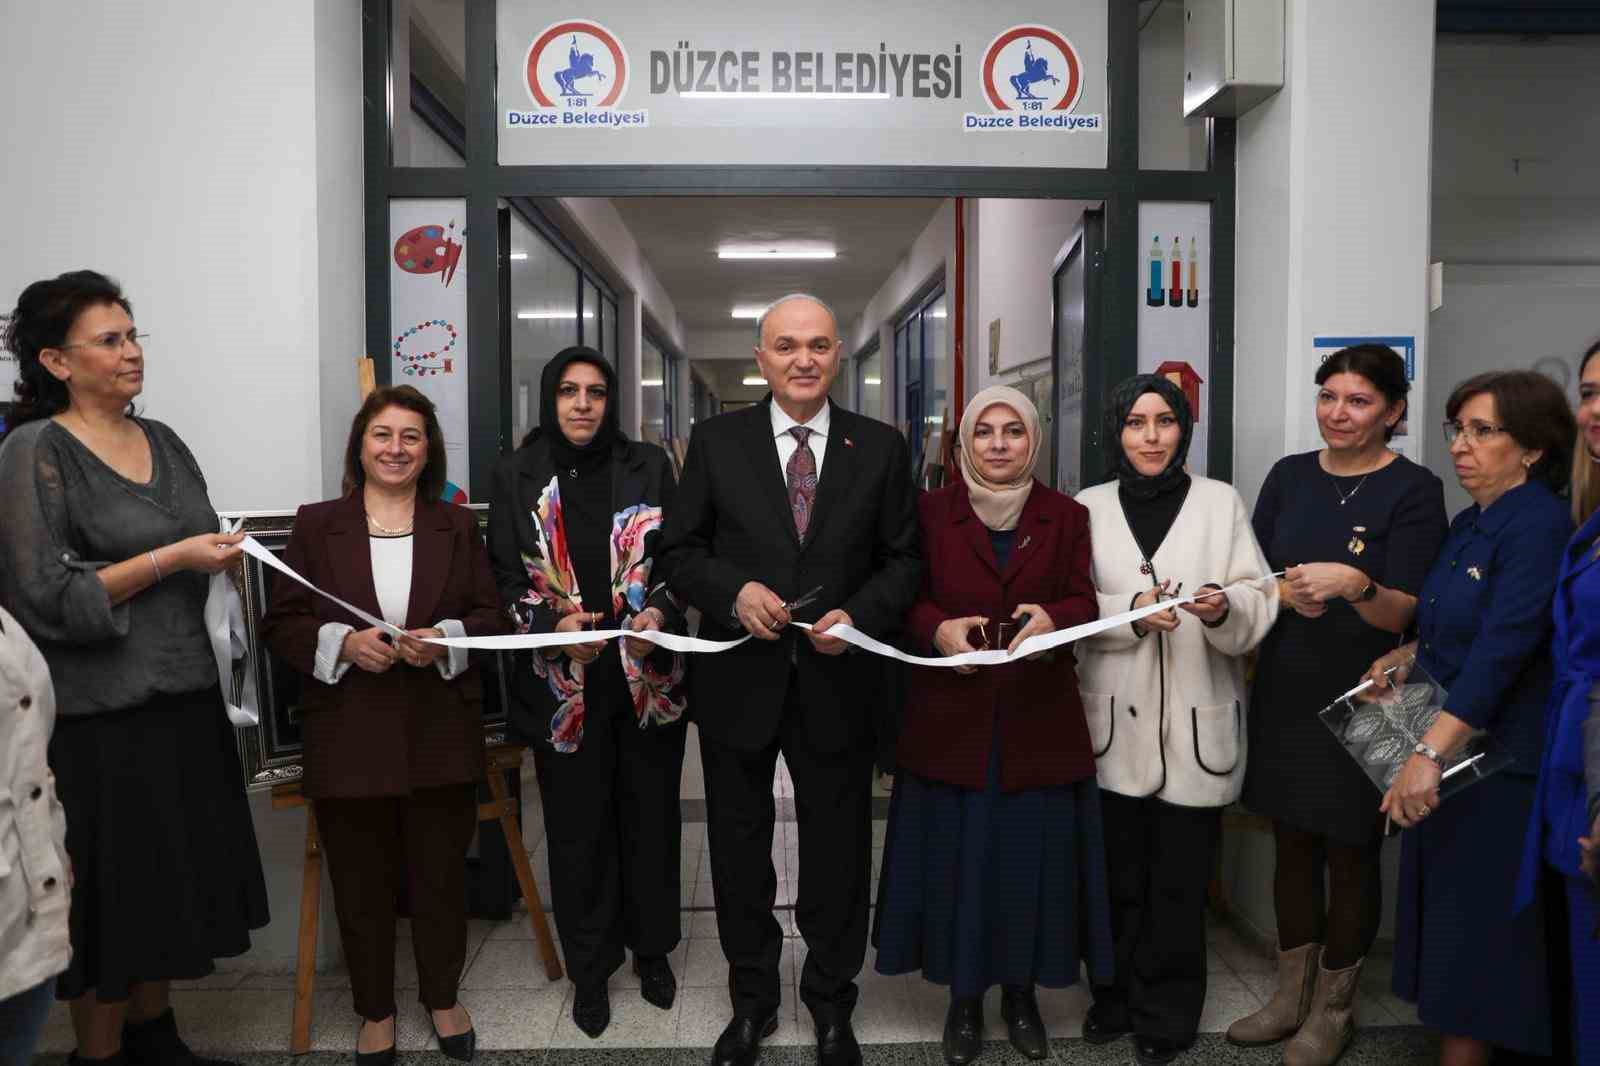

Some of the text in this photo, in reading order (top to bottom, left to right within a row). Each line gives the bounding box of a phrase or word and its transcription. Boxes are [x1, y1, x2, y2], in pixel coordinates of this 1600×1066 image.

[650, 40, 962, 99] DÜZCE BELEDİYESİ
[509, 111, 645, 127] Düzce Belediyesi
[966, 114, 1098, 130] Düzce Belediyesi
